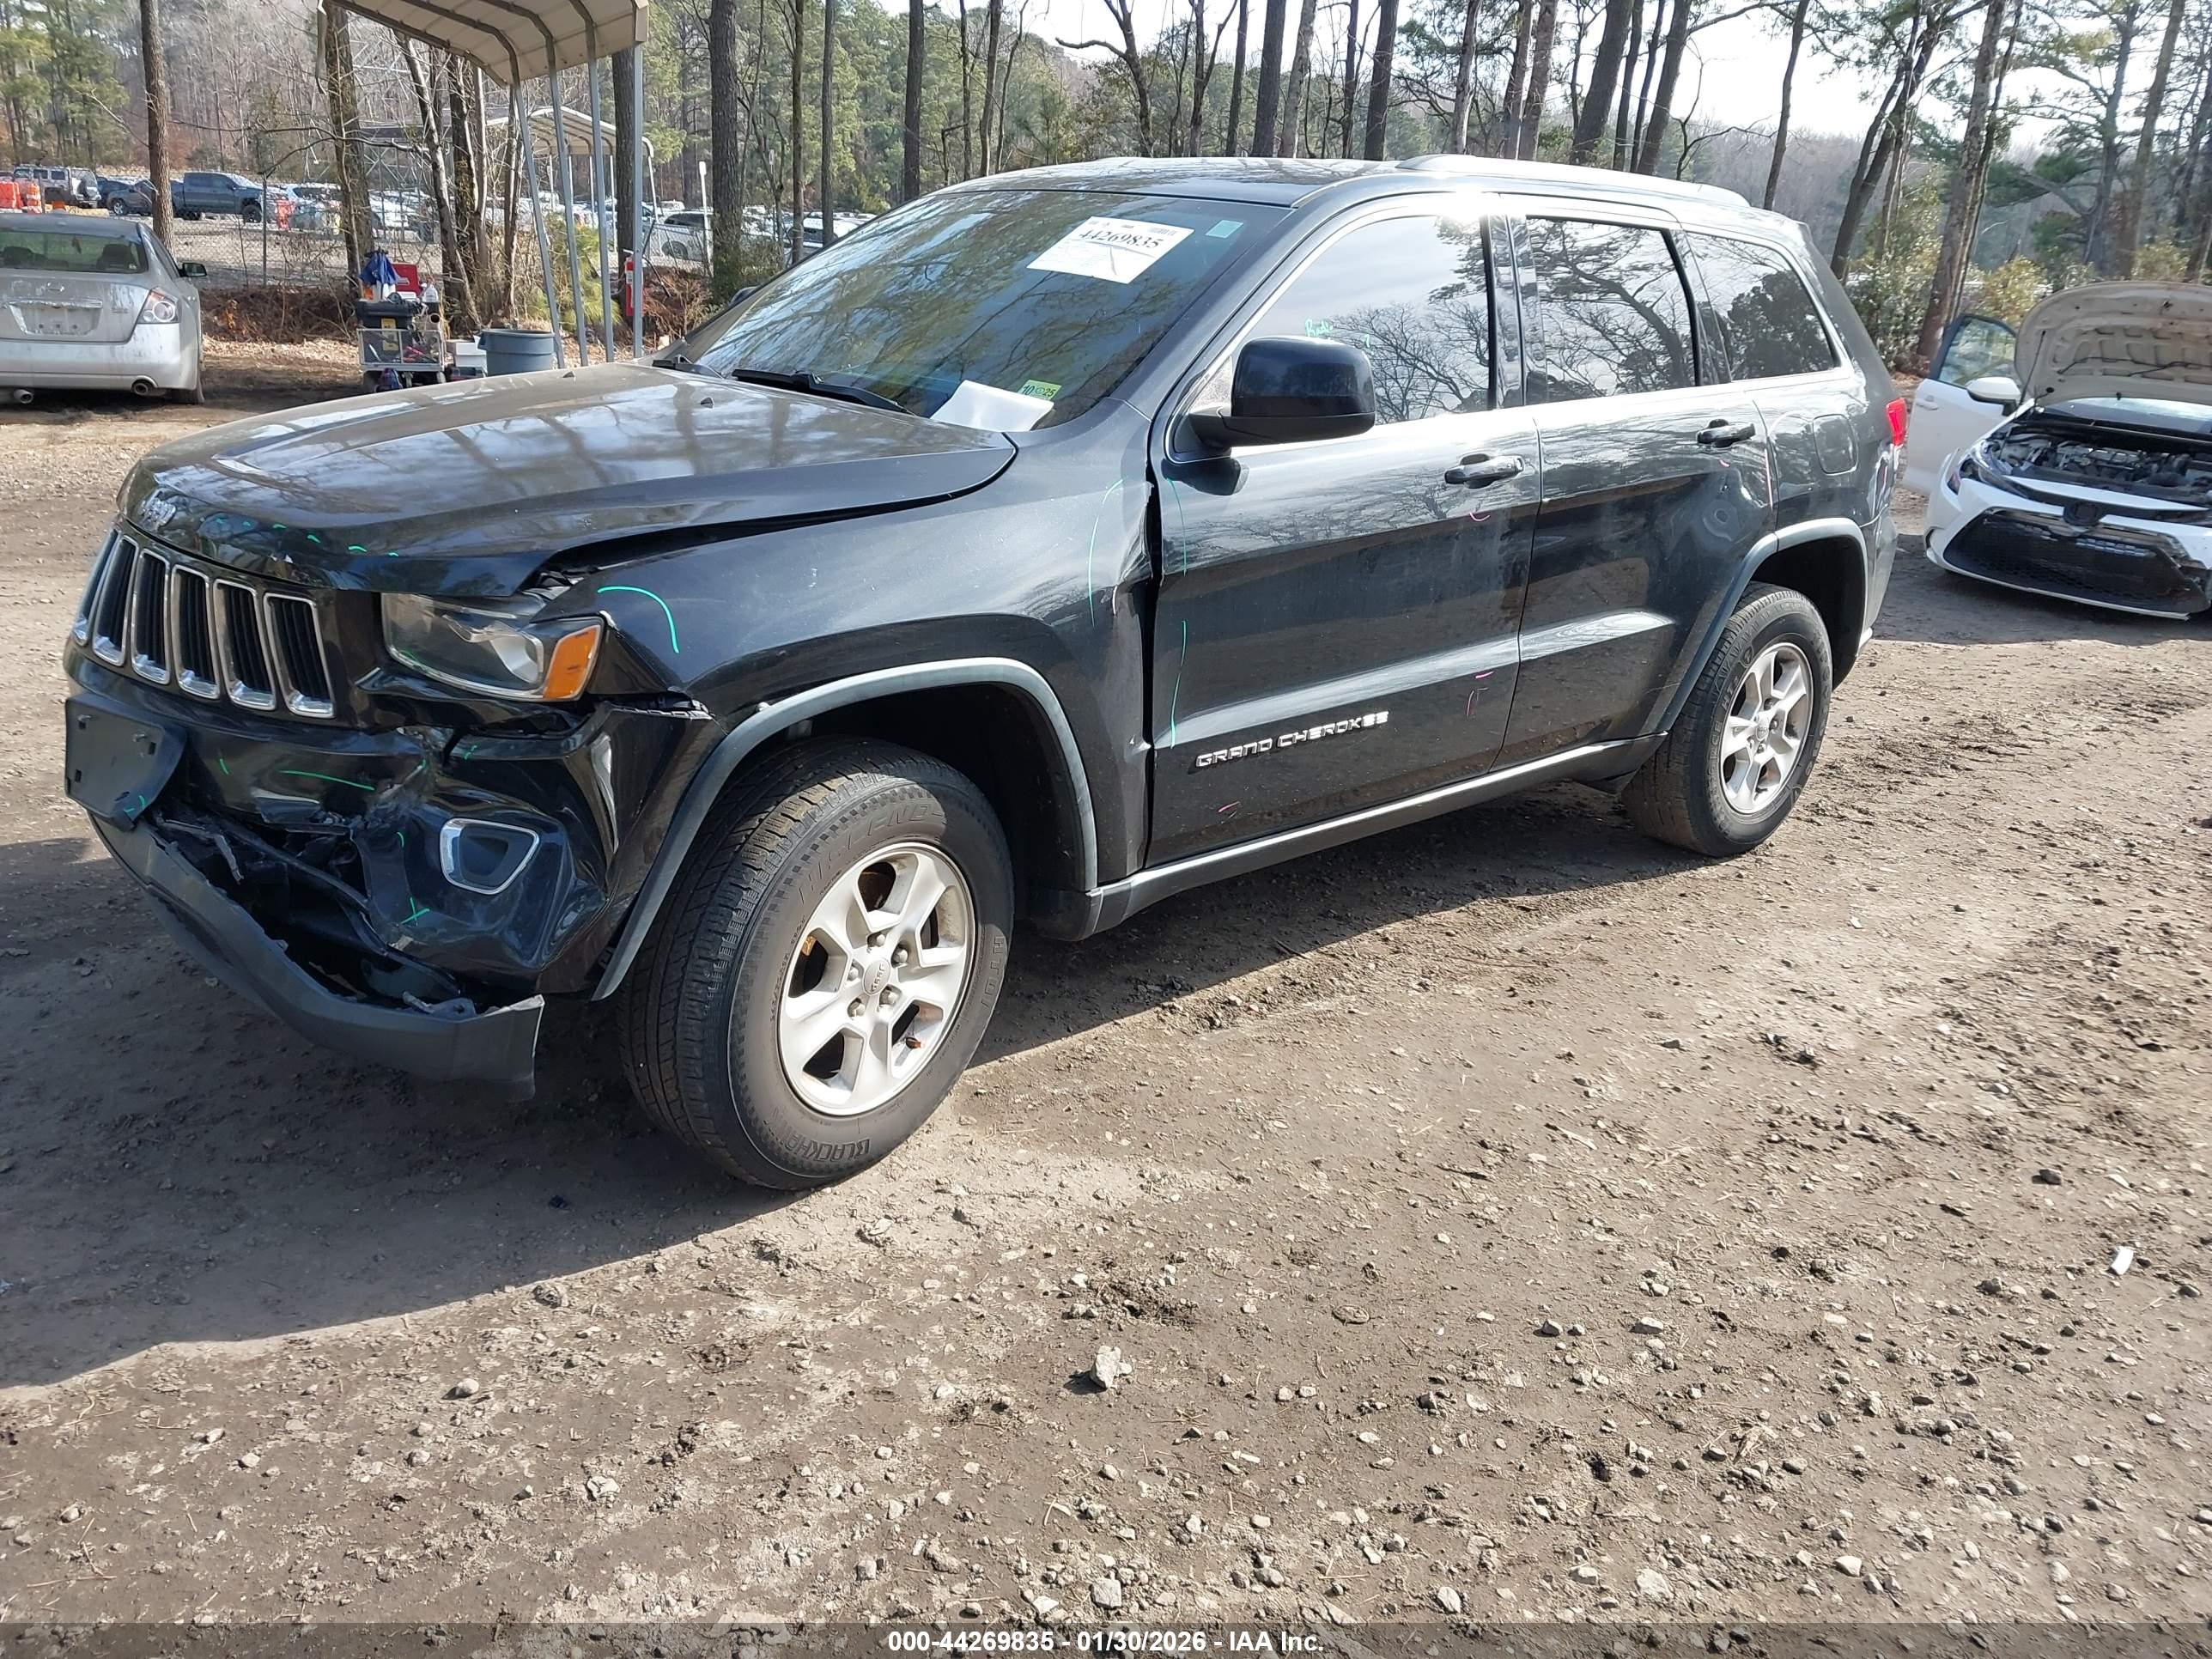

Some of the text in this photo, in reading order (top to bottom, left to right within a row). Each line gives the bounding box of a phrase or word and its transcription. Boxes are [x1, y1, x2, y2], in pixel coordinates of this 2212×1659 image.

[1079, 228, 1164, 248] 44269835
[1022, 385, 1056, 397] 10 25
[1194, 710, 1389, 768] GRAND CHEROKEE
